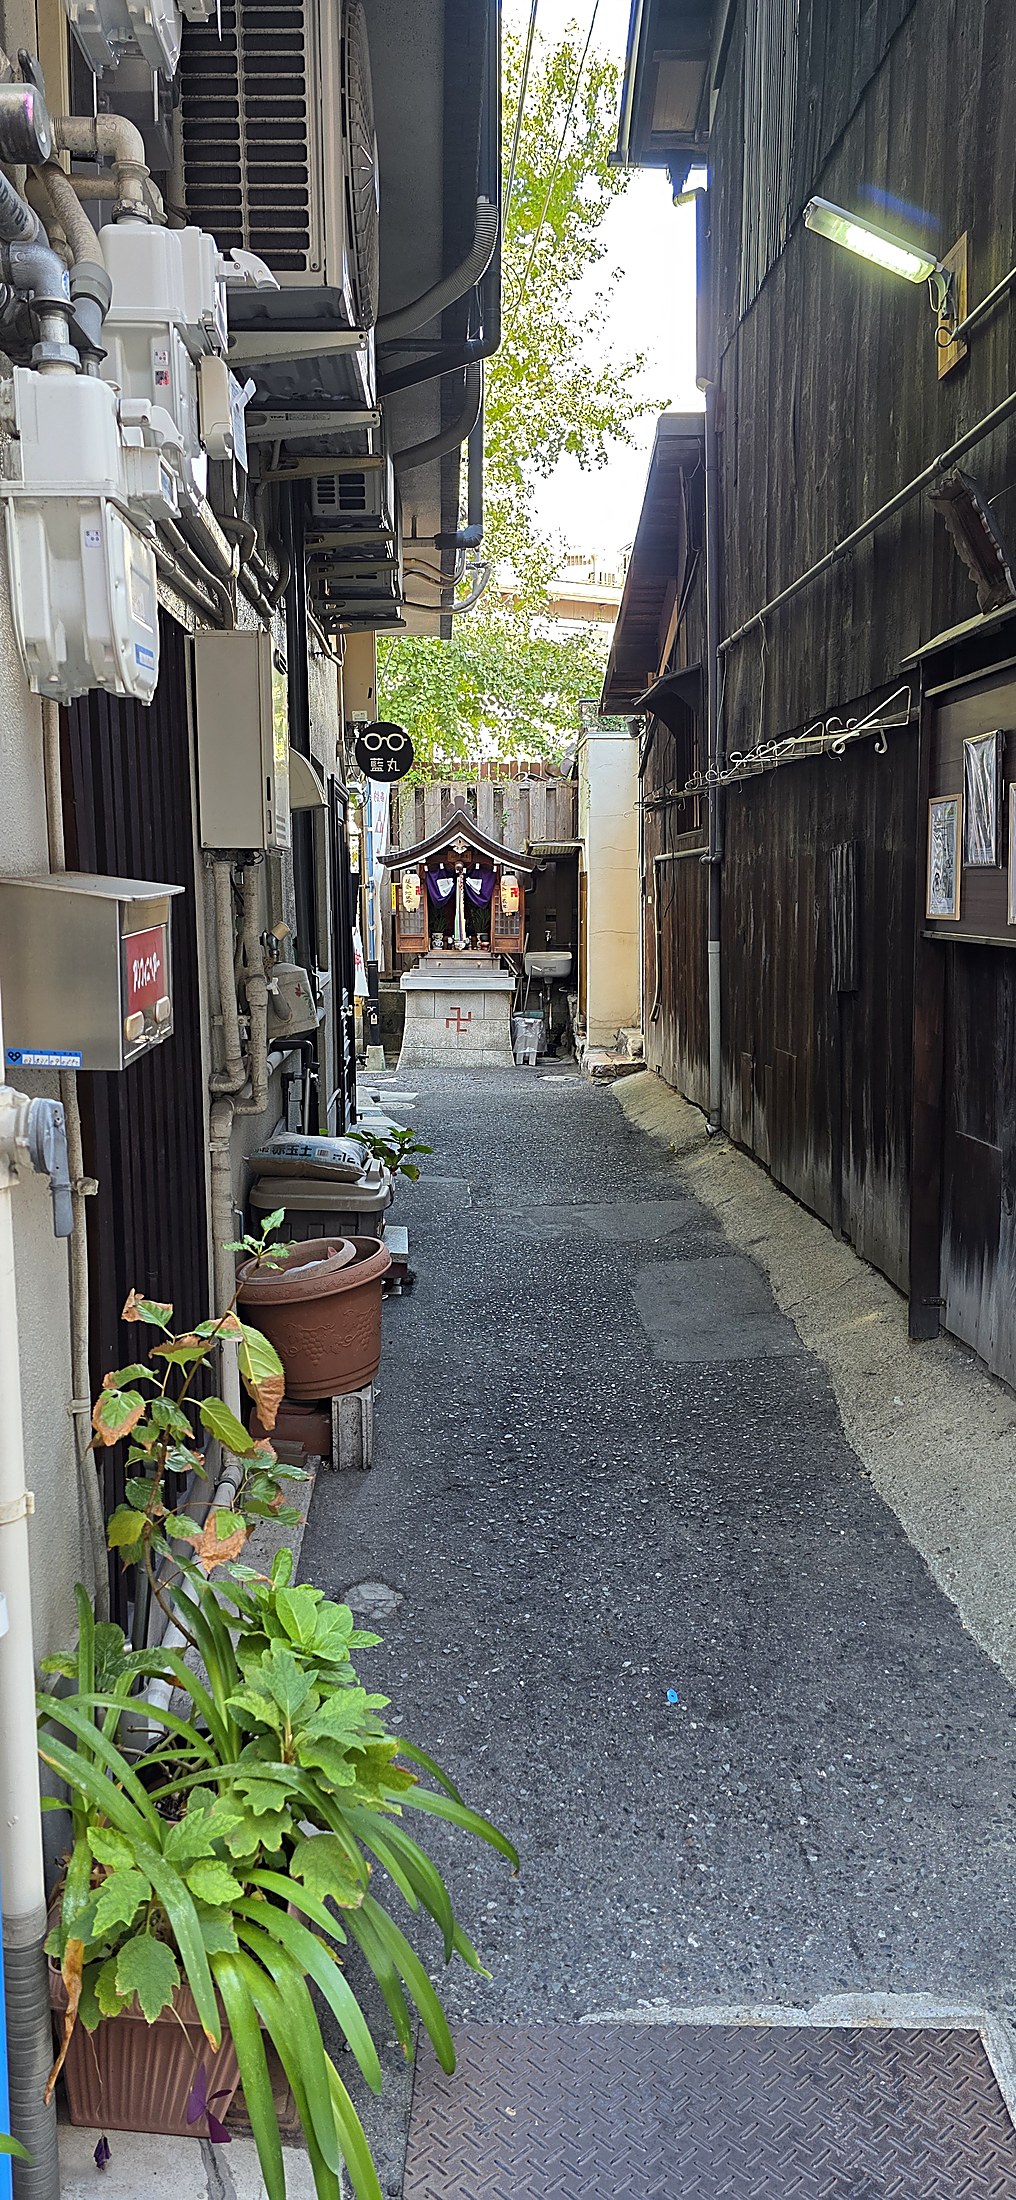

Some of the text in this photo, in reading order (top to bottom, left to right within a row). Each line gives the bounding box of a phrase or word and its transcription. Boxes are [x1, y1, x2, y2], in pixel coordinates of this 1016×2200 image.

[369, 757, 401, 773] 藍丸
[271, 1144, 313, 1158] 赤玉土
